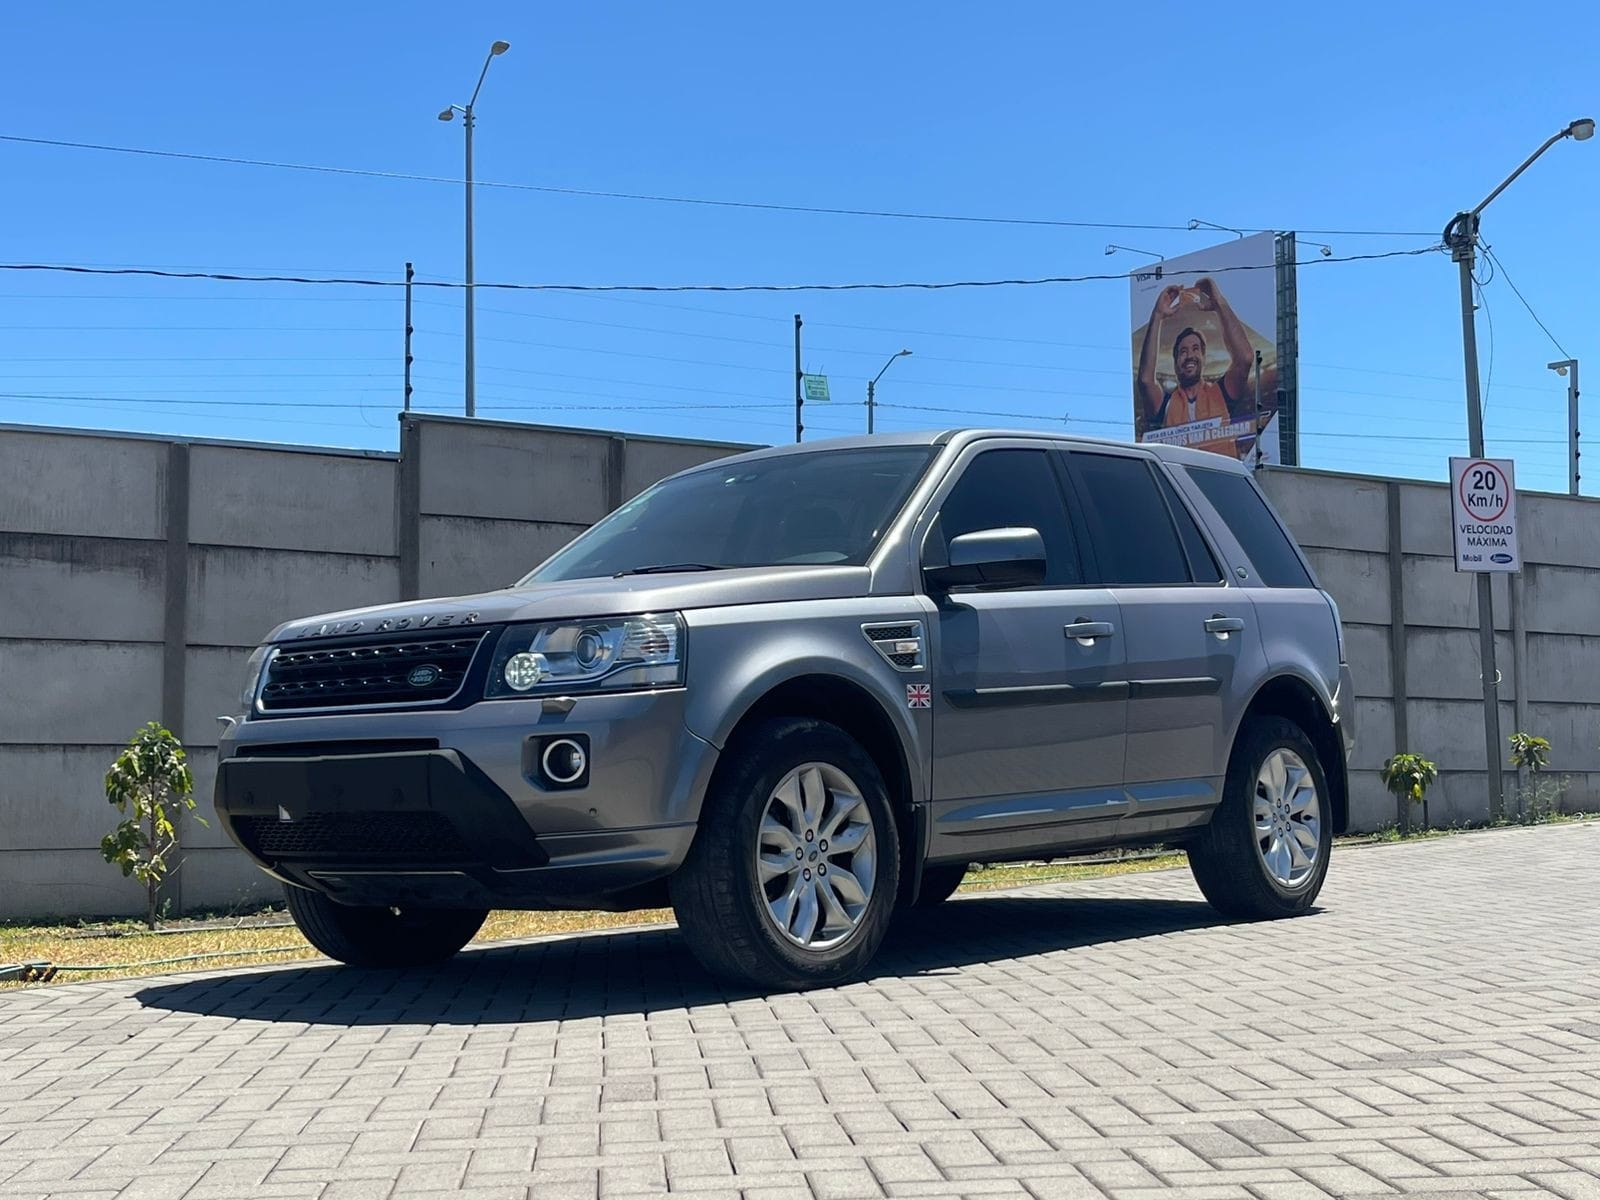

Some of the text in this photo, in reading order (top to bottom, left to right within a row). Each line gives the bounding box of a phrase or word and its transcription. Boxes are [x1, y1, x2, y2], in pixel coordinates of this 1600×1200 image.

[1472, 470, 1496, 491] 20
[1467, 493, 1503, 508] Km/h
[1460, 525, 1513, 535] VELOCIDAD
[1462, 554, 1482, 562] Mobil
[297, 612, 480, 638] LAND ROVER
